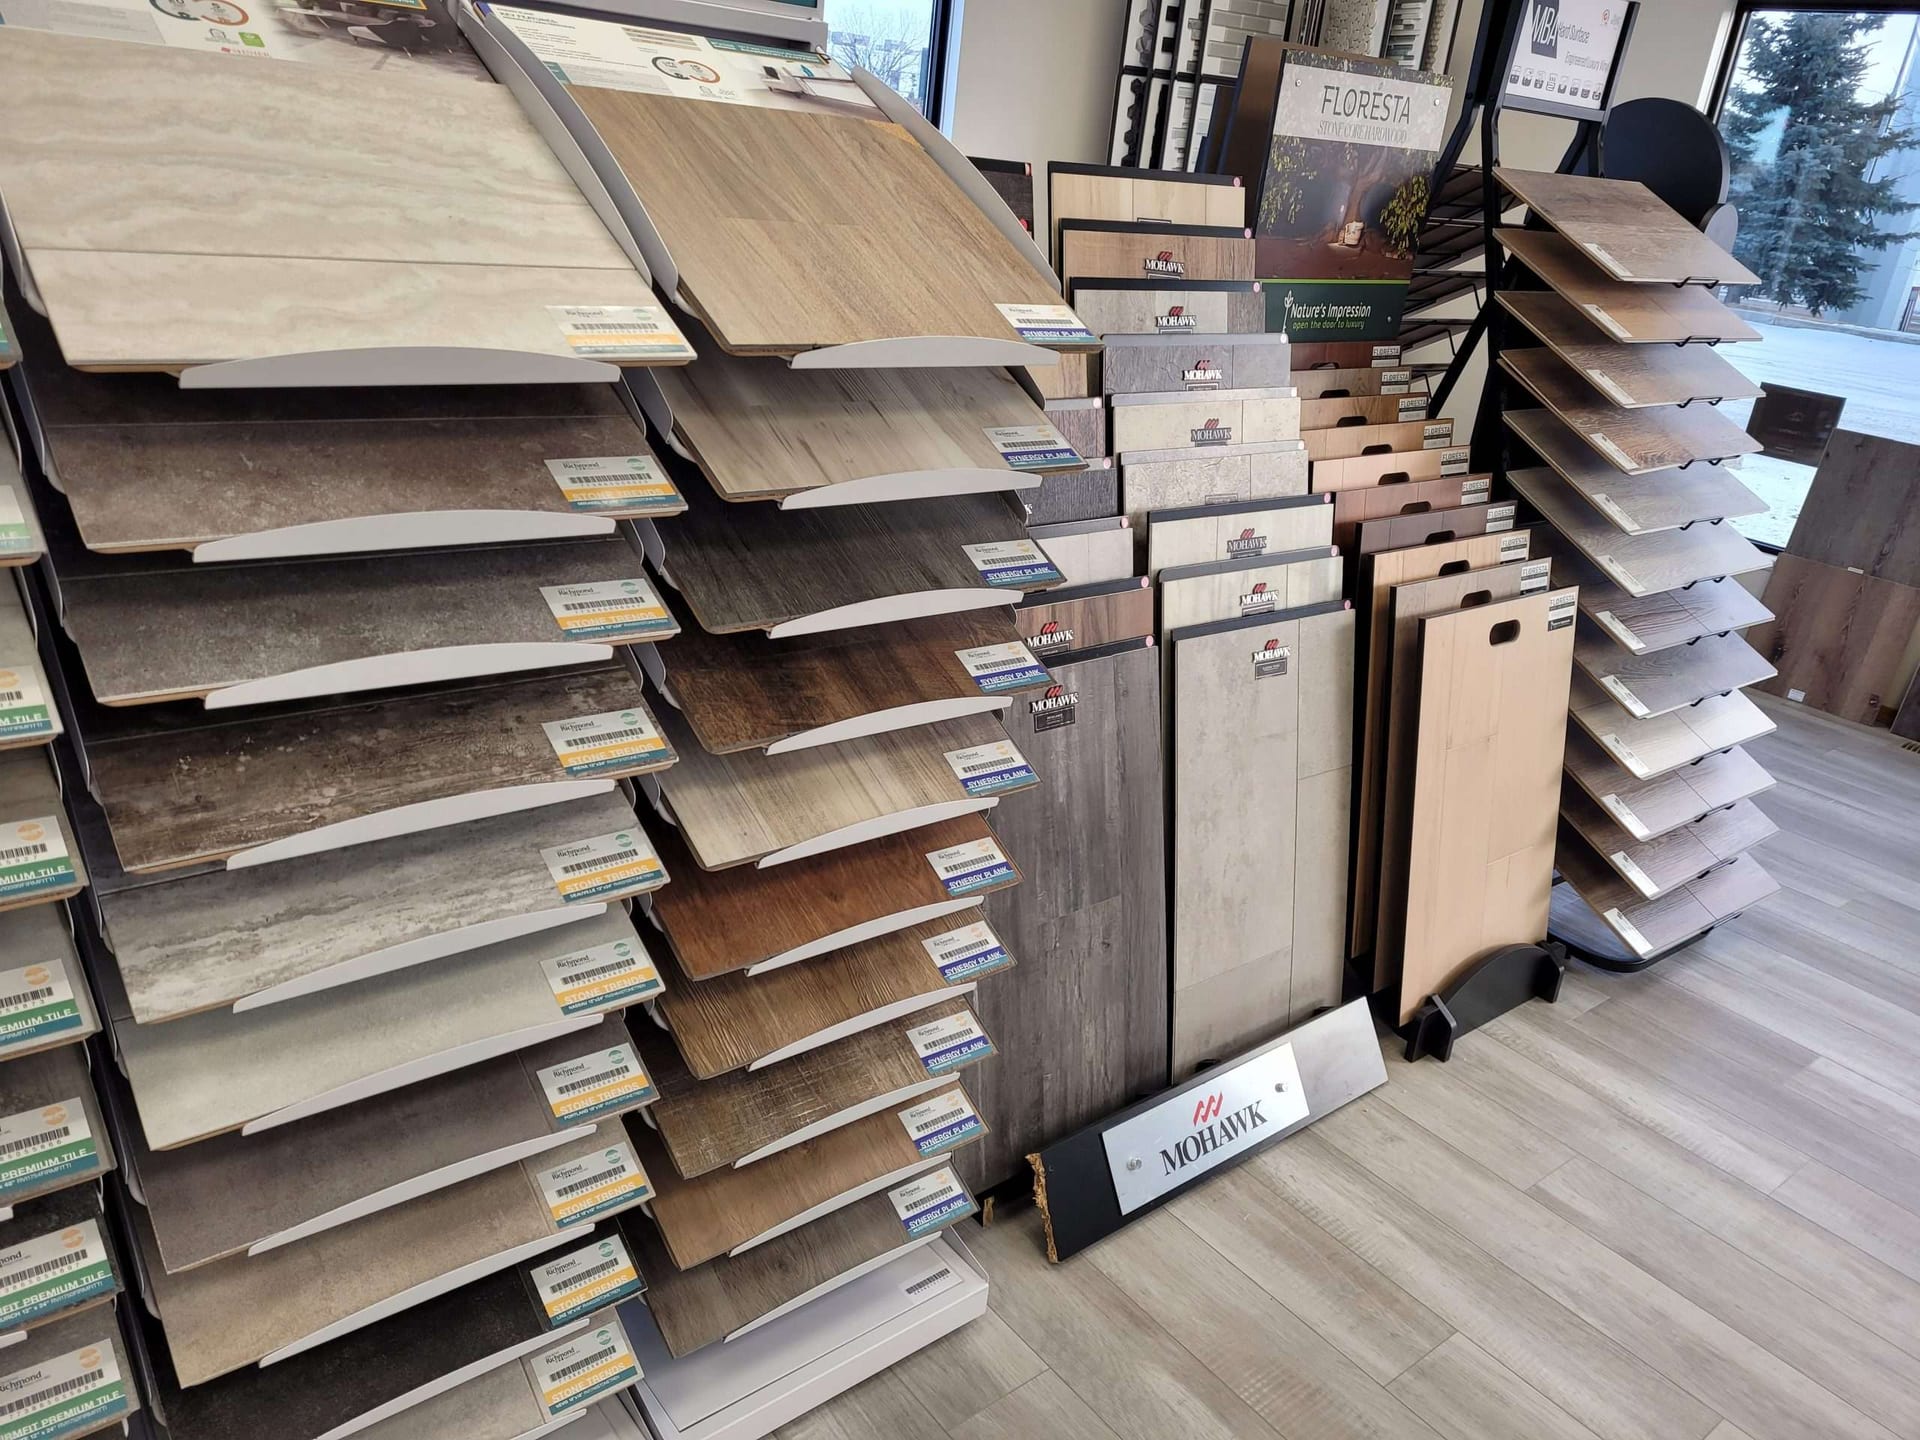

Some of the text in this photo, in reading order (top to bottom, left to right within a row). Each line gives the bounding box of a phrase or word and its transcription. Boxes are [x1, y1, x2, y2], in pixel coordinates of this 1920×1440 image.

[1318, 121, 1407, 143] STONE CORE HARDWOOD
[1145, 259, 1184, 273] MOHAWK
[1291, 303, 1371, 321] Nature's Impression
[1157, 316, 1196, 327] MOHAWK
[1293, 319, 1364, 330] open the door to luxury
[1184, 370, 1222, 380] MOHAWK
[1192, 428, 1231, 440] MOHAWK
[1008, 454, 1044, 462] SYNERGY
[1228, 536, 1266, 552] MOHAWK
[987, 570, 1022, 580] SYNERGY
[1023, 567, 1049, 576] PLANK
[1241, 591, 1279, 606] MOHAWK
[566, 618, 606, 628] STONE
[610, 612, 656, 623] TRENDS
[1027, 630, 1073, 647] MOHAWK
[1254, 646, 1291, 663] MOHAWK
[979, 673, 1015, 685] SYNERGY
[1016, 669, 1041, 679] PLANK
[1032, 693, 1079, 713] MOHAWK
[14, 713, 41, 723] TILE
[568, 752, 606, 765] STONE
[610, 744, 655, 758] TRENDS
[967, 777, 1001, 788] SYNERGY
[1002, 770, 1027, 781] PLANK
[38, 866, 65, 876] TILE
[566, 878, 604, 893] STONE
[607, 865, 648, 883] TRENDS
[949, 875, 983, 889] SYNERGY
[984, 867, 1009, 879] PLANK
[556, 955, 589, 968] Richmond
[944, 960, 978, 976] SYNERGY
[978, 952, 1002, 965] PLANK
[564, 988, 602, 1004] STONE
[604, 974, 645, 992] TRENDS
[46, 1009, 72, 1020] TILE
[928, 1050, 961, 1066] SYNERGY
[962, 1041, 985, 1055] PLANK
[553, 1064, 585, 1078] Richmond
[560, 1097, 596, 1114] STONE
[600, 1082, 639, 1100] TRENDS
[920, 1131, 952, 1149] SYNERGY
[952, 1120, 976, 1135] PLANK
[1159, 1100, 1268, 1176] MOHAWK
[1, 1157, 59, 1180] PREMIUM
[62, 1148, 87, 1161] TILE
[552, 1165, 582, 1180] Richmond
[559, 1199, 594, 1218] STONE
[596, 1182, 634, 1202] TRENDS
[909, 1210, 941, 1228] SYNERGY
[941, 1198, 965, 1214] PLANK
[546, 1259, 576, 1276] Richmond
[23, 1281, 79, 1306] PREMIUM
[80, 1271, 104, 1284] TILE
[552, 1295, 586, 1315] STONE
[590, 1275, 628, 1296] TRENDS
[546, 1347, 575, 1365] Richmond
[552, 1382, 585, 1402] STONE
[588, 1362, 625, 1384] TRENDS
[41, 1400, 94, 1426] PREMIUM
[96, 1391, 120, 1404] TILE
